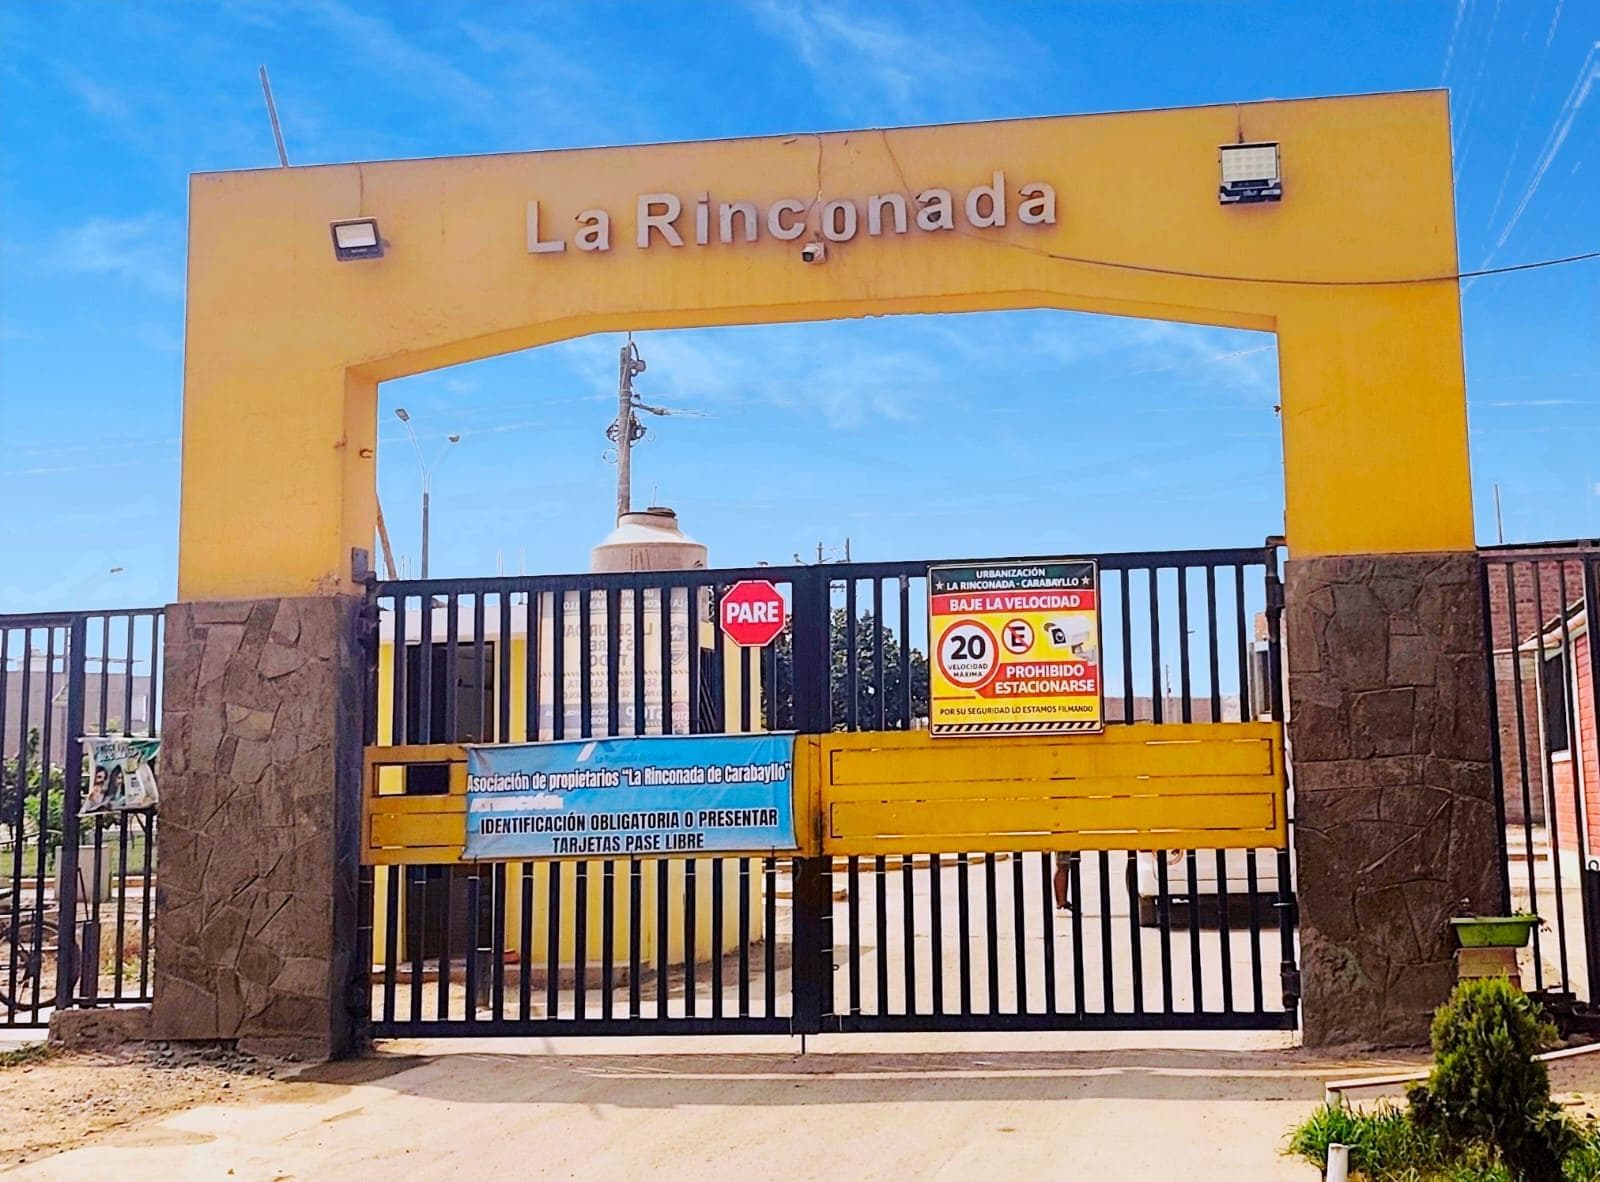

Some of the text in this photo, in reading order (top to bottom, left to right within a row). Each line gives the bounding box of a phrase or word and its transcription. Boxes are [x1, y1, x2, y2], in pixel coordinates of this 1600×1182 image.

[526, 170, 1057, 255] La Rinconada
[976, 567, 1045, 579] URBANIZACIÓN
[946, 581, 959, 591] LA
[960, 579, 1015, 590] RINCONADA
[1021, 577, 1079, 588] CARABAYLLO
[950, 595, 1080, 611] BAJE LA VELOCIDAD
[726, 601, 779, 624] PARE
[950, 635, 986, 660] 20
[948, 663, 988, 671] VELOCIDAD
[1006, 664, 1084, 678] PROHIBIDO
[995, 679, 1095, 695] ESTACIONARSE
[940, 707, 956, 715] POR
[956, 707, 967, 715] SU
[967, 706, 1011, 715] SEGURIDAD
[1022, 705, 1057, 713] ESTAMOS
[1058, 705, 1093, 713] FILMANDO
[467, 770, 530, 793] Asociación
[532, 772, 546, 790] de
[549, 768, 619, 792] propietarios
[644, 765, 704, 786] Rinconada
[707, 765, 722, 783] de
[480, 809, 778, 835] IDENTIFICACIÓN OBLIGATORIA O PRESENTAR
[552, 833, 704, 854] TARJETAS PASE LIBRE
